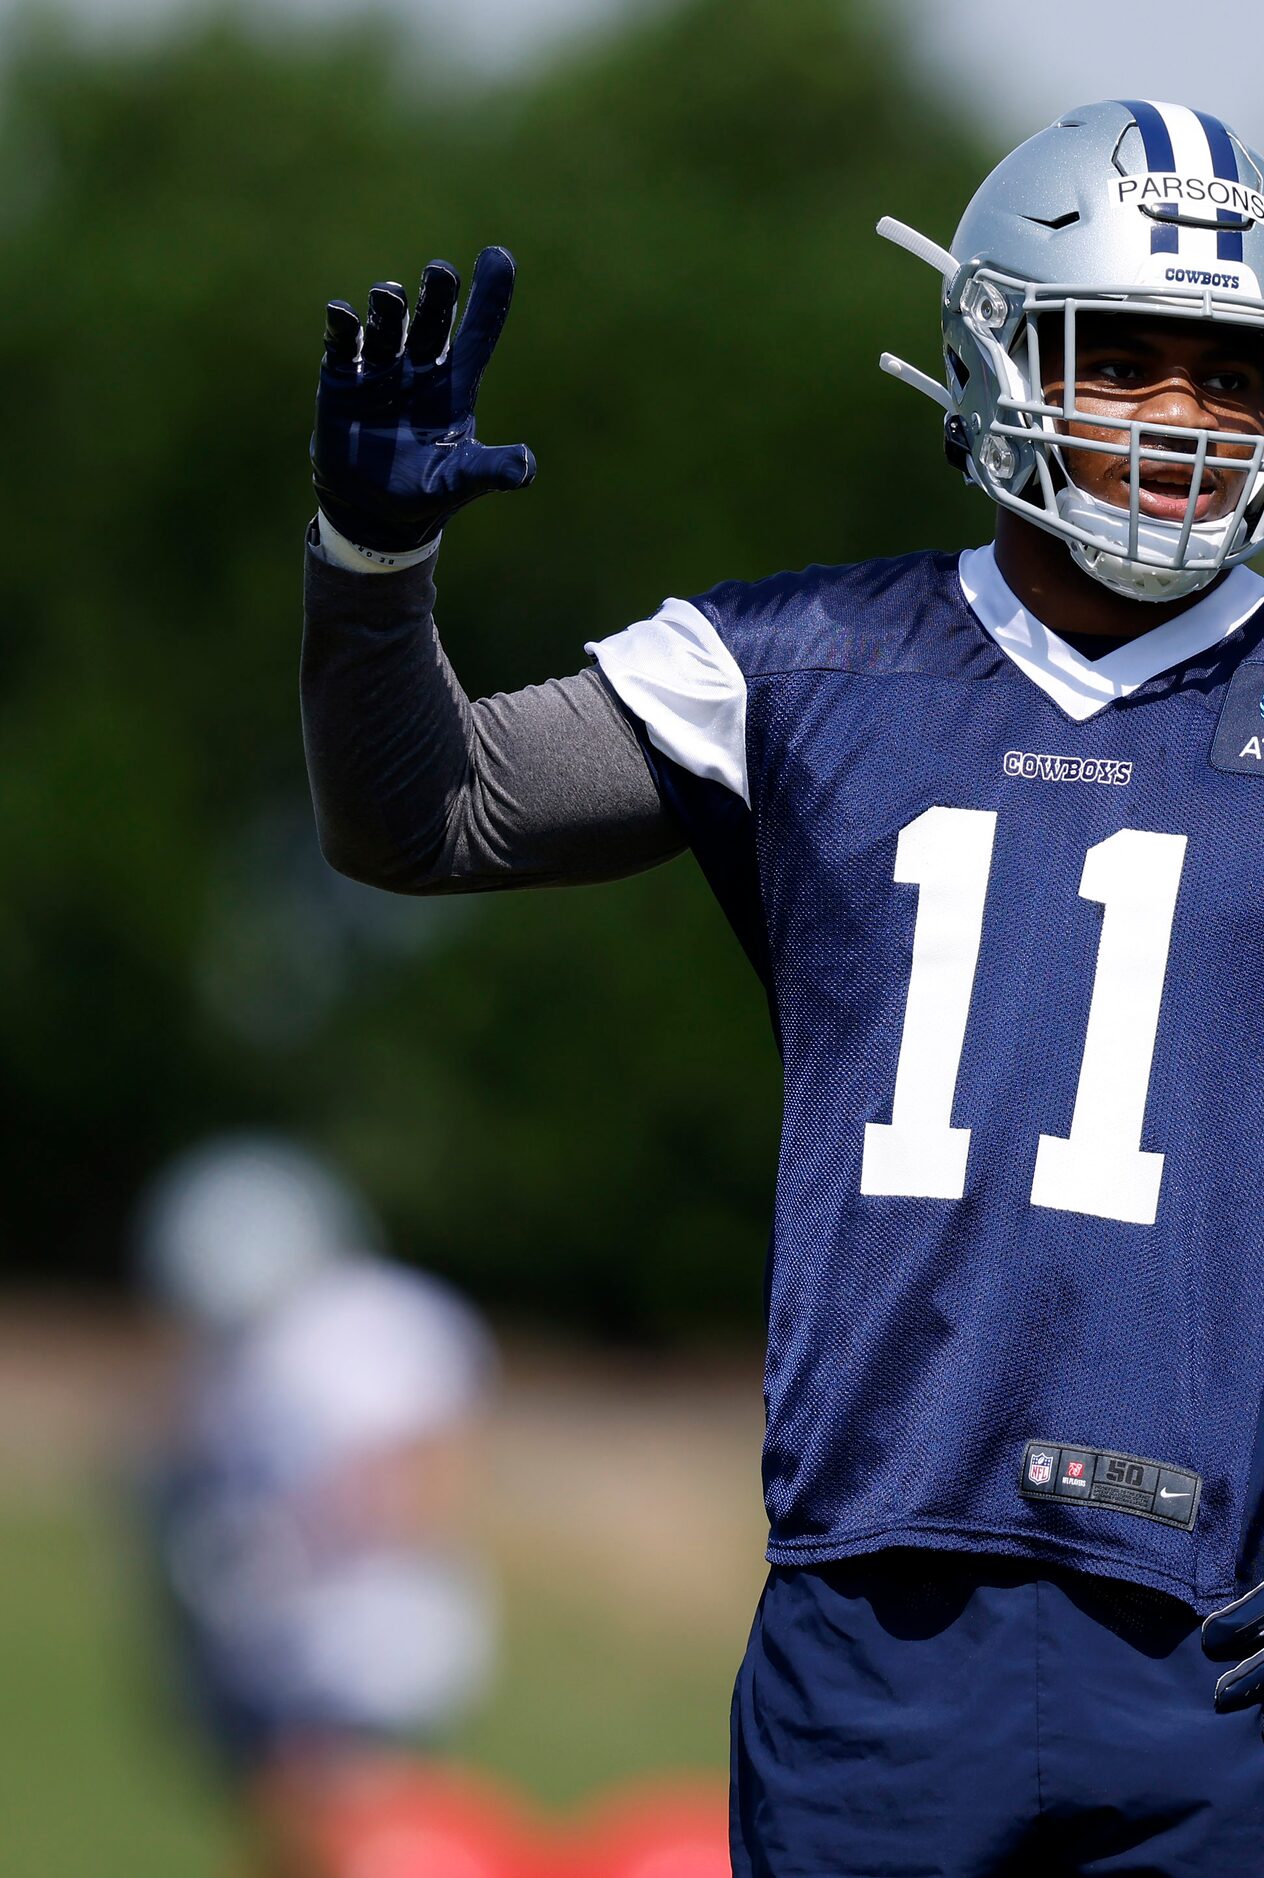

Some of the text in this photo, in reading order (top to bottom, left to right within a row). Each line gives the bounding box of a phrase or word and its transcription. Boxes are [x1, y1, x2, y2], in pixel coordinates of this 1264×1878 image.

[1165, 268, 1240, 289] COWBOYS
[1004, 751, 1133, 786] COWBOYS
[860, 805, 1188, 1225] 11
[1031, 1466, 1047, 1480] NFL
[1105, 1459, 1145, 1487] 50
